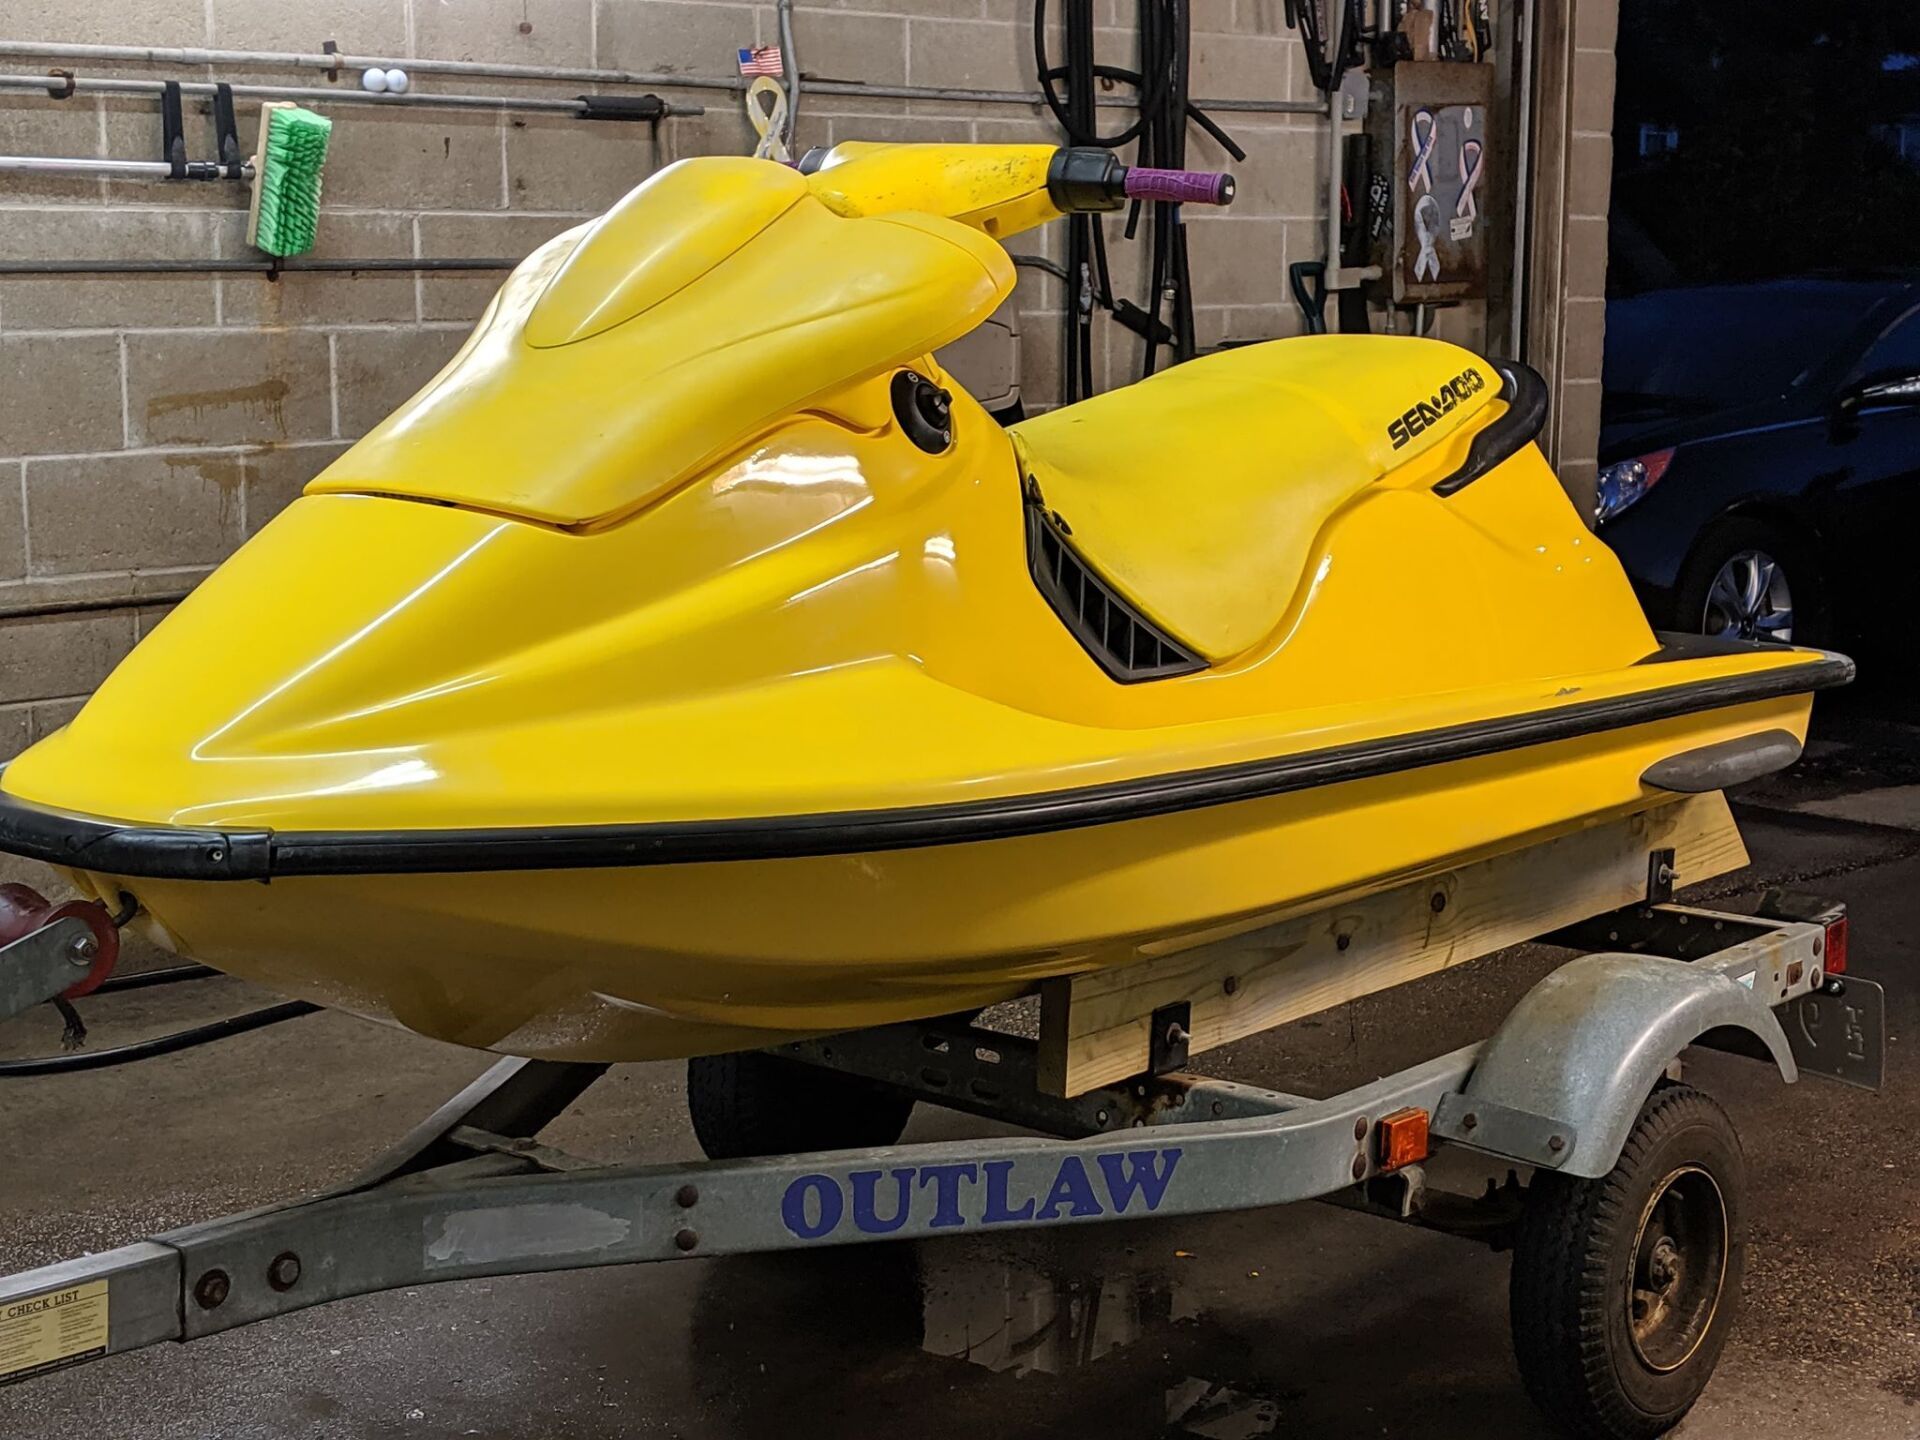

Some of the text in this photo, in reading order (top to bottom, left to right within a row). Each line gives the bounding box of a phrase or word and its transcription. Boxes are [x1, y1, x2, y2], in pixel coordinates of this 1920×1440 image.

[781, 1148, 1183, 1239] OUTLAW
[7, 1298, 50, 1318] CHECK
[54, 1289, 79, 1306] LIST
